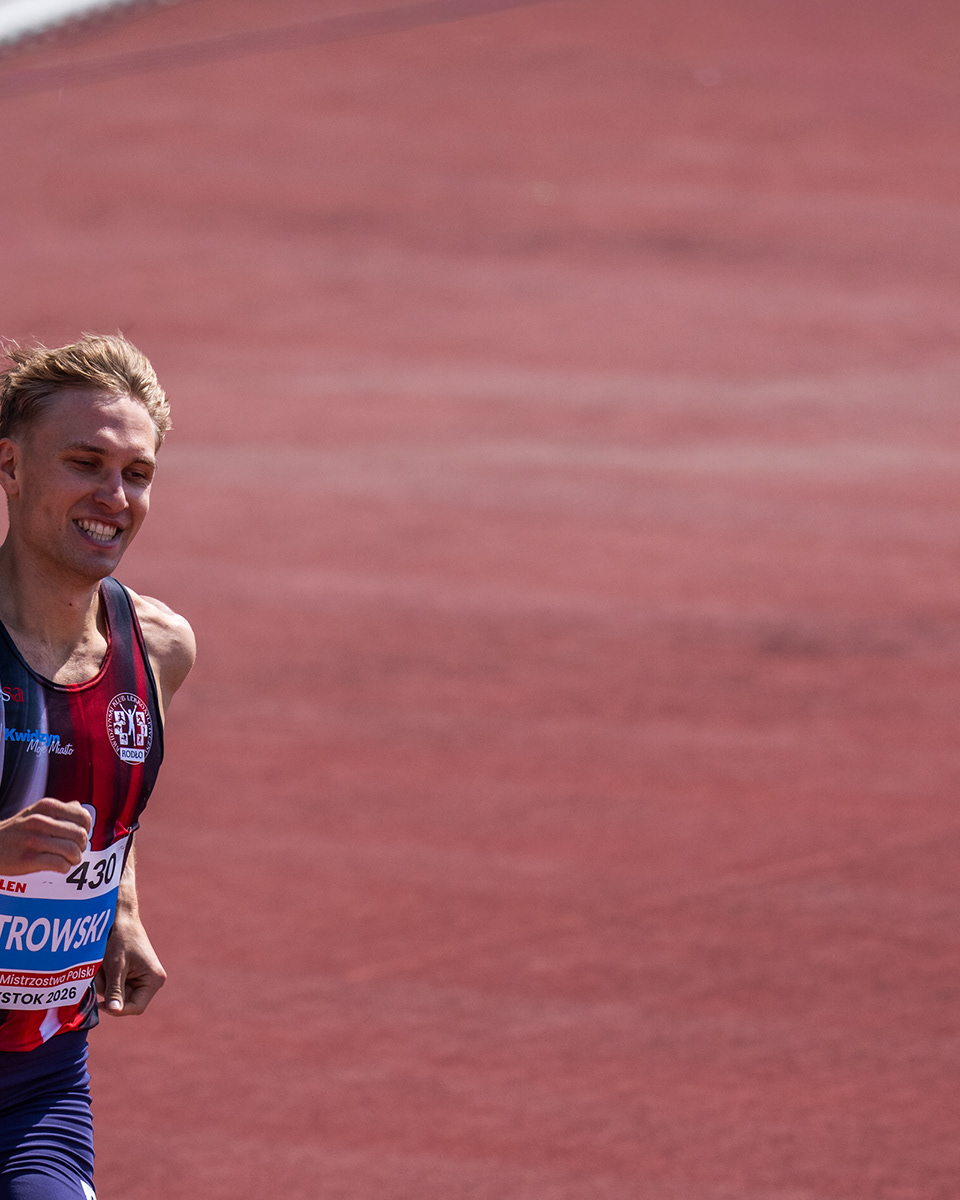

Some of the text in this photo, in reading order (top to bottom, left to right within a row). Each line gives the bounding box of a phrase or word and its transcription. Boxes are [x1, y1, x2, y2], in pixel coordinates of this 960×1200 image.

[112, 695, 127, 708] KLUB
[5, 728, 60, 747] Kwidzyn
[48, 740, 75, 756] Miasto
[121, 749, 144, 760] RODŁO
[66, 852, 117, 891] 430
[0, 973, 66, 988] Mistrzostwa
[66, 965, 96, 982] Polski
[46, 986, 77, 1004] 2026
